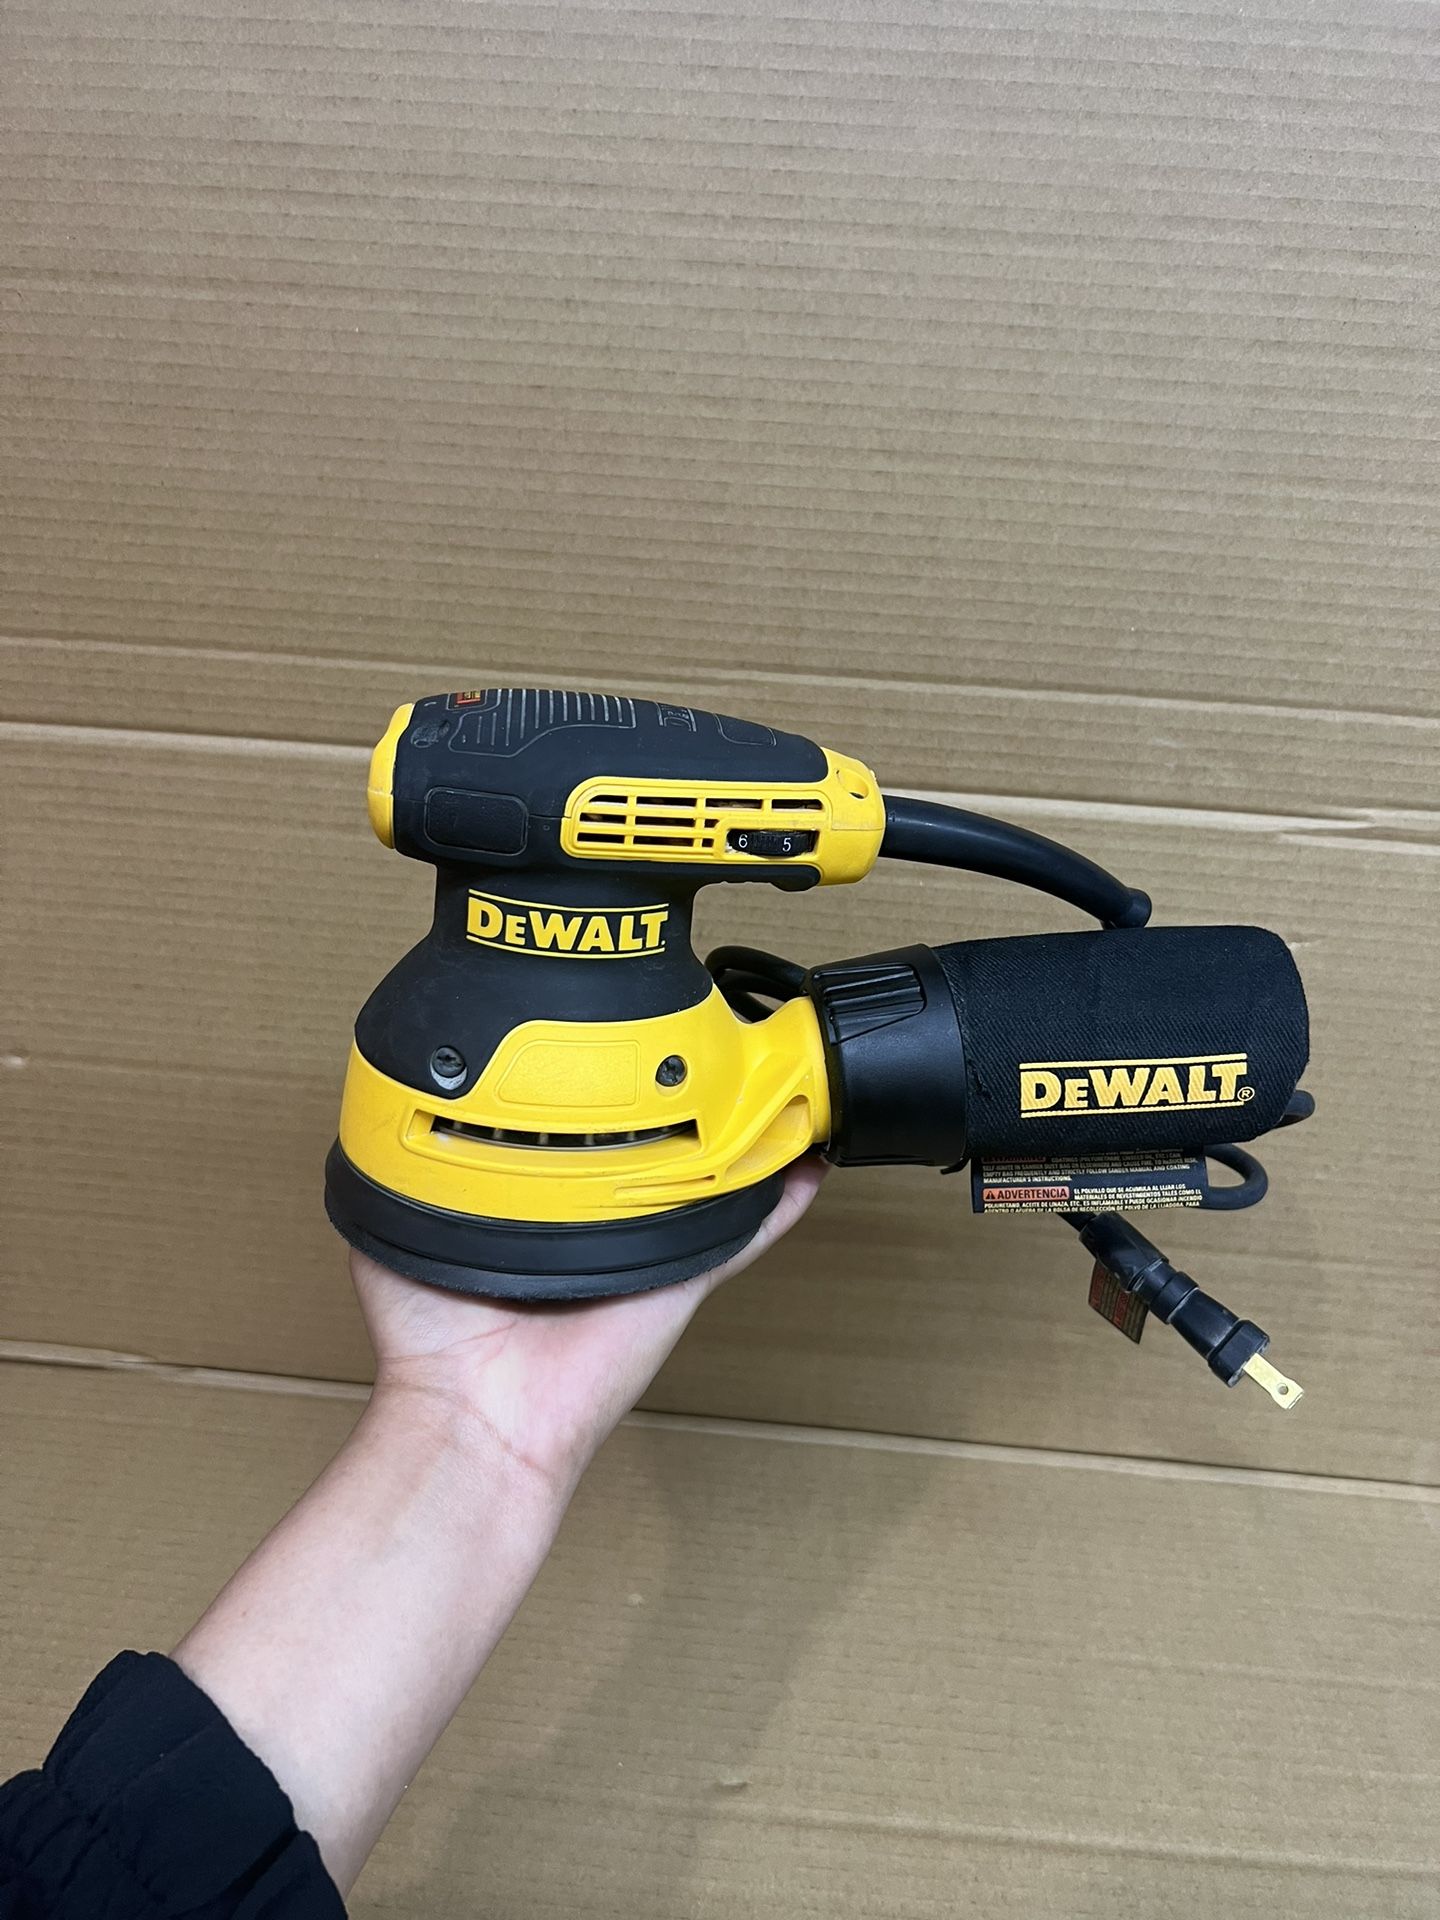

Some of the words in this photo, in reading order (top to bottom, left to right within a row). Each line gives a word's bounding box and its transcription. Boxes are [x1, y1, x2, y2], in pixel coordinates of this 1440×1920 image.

[738, 833, 748, 848] 6
[782, 837, 791, 852] 5
[997, 1188, 1067, 1199] ADVERTENCIA
